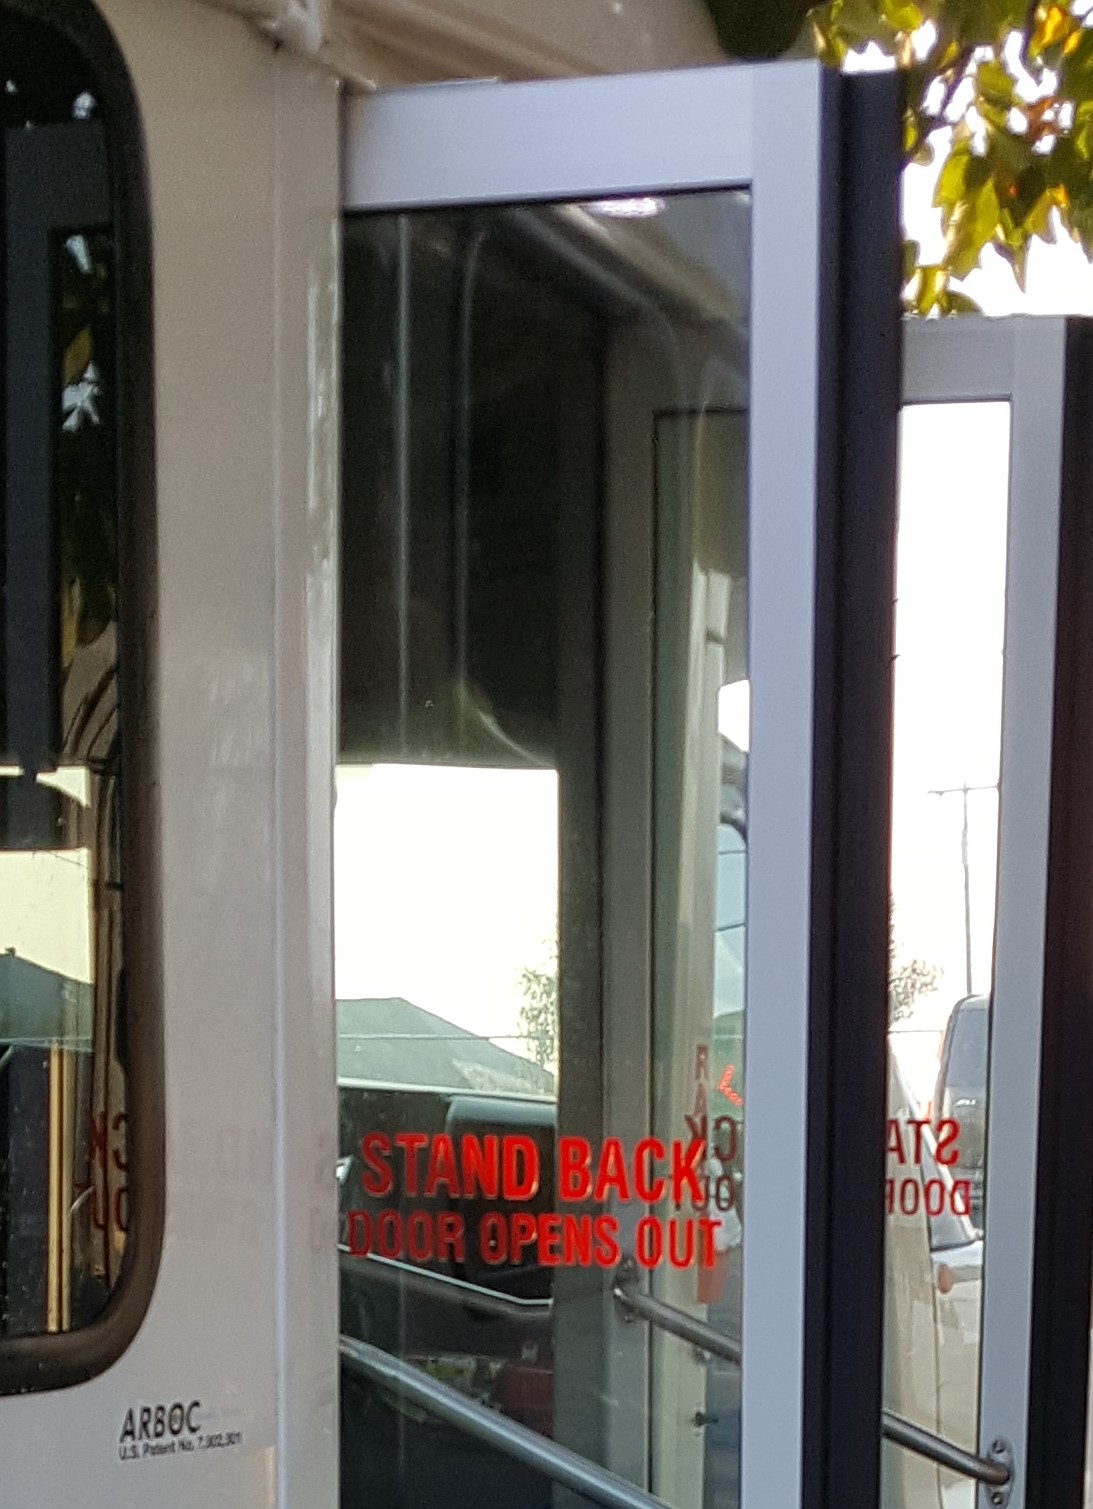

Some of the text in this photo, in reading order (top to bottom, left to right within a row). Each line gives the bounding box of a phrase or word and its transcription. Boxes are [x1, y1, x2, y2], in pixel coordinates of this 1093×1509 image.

[361, 1132, 707, 1205] STAND BACK
[347, 1209, 724, 1270] DOOR OPENS OUT
[120, 1400, 202, 1443] ARBOC
